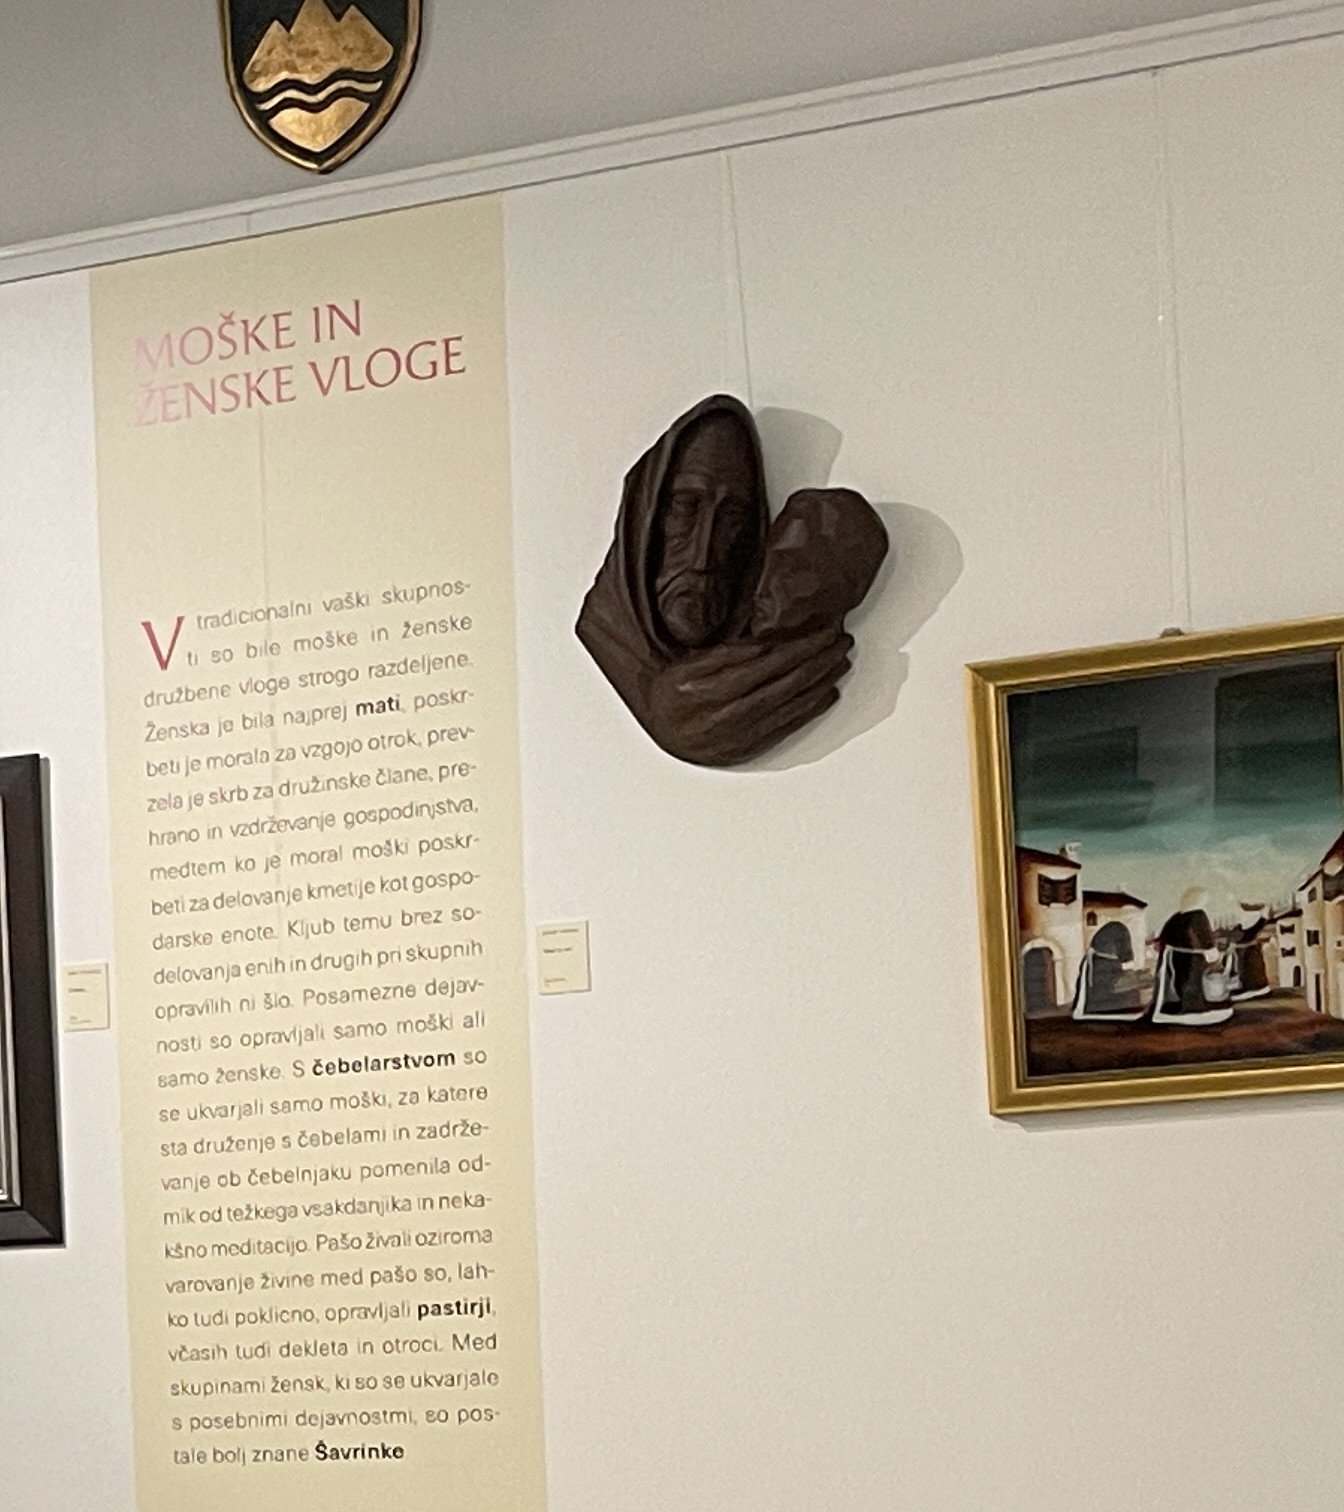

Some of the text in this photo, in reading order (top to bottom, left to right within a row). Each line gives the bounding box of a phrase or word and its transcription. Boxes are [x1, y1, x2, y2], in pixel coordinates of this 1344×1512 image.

[135, 299, 361, 371] MOŠKE IN
[135, 335, 467, 428] ŽENSKE VLOGE
[140, 615, 186, 671] V
[196, 600, 312, 630] tradicionalni
[322, 591, 370, 613] vaški
[187, 615, 472, 667] ti so bile moške in ženske
[143, 683, 231, 709] družbene
[238, 676, 290, 697] vloge
[298, 667, 360, 688] strogo
[144, 720, 210, 743] Ženska
[217, 719, 234, 738] je
[241, 711, 275, 731] bila
[282, 704, 348, 727] najprej
[146, 759, 181, 778] beti
[184, 756, 202, 778] je
[206, 747, 270, 770] morala
[274, 746, 297, 763] za
[301, 738, 364, 761] vzgojo
[147, 792, 184, 813] zela
[188, 792, 204, 812] je
[208, 784, 249, 806] skrb
[252, 785, 274, 801] za
[278, 771, 371, 797] družinske
[148, 827, 200, 847] hrano
[206, 825, 223, 840] in
[229, 812, 336, 838] vzdrževanje
[149, 860, 226, 882] medtem
[234, 855, 256, 872] ko
[263, 854, 282, 874] je
[290, 844, 343, 867] moral
[352, 838, 409, 861] moški
[151, 898, 185, 916] beti
[189, 897, 210, 913] za
[212, 887, 303, 910] delovanje
[306, 879, 376, 900] kmetije
[379, 875, 409, 893] kot
[152, 930, 213, 951] darske
[287, 917, 336, 940] Kljub
[343, 914, 393, 933] temu
[400, 909, 443, 927] brez
[153, 939, 483, 985] delovanja enih in drugih pri skupnih
[154, 997, 232, 1022] opravilih
[239, 998, 256, 1012] ni
[302, 983, 417, 1006] Posamezne
[156, 1010, 486, 1054] nosti so opravljali samo moški ali
[157, 1071, 210, 1089] samo
[292, 1059, 306, 1079] S
[311, 1052, 456, 1077] čebelarstvom
[463, 1049, 488, 1066] so
[158, 1085, 488, 1123] se ukvarjali samo moški, za katere
[160, 1141, 188, 1158] sta
[193, 1135, 276, 1155] druženje
[281, 1135, 292, 1149] s
[297, 1127, 387, 1149] čebelami
[392, 1126, 411, 1141] in
[161, 1174, 211, 1193] vanje
[217, 1169, 242, 1188] ob
[247, 1165, 352, 1187] čebelnjaku
[359, 1156, 451, 1183] pomenila
[163, 1207, 196, 1226] mik
[199, 1205, 223, 1224] od
[226, 1203, 299, 1223] težkega
[417, 1196, 435, 1211] in
[164, 1242, 208, 1260] kšno
[315, 1232, 363, 1252] Pašo
[365, 1230, 412, 1250] živali
[414, 1228, 493, 1247] oziroma
[165, 1275, 255, 1295] varovanje
[260, 1271, 315, 1290] živine
[320, 1267, 364, 1286] med
[370, 1265, 418, 1288] pašo
[423, 1267, 452, 1283] so,
[167, 1311, 189, 1328] ko
[193, 1309, 229, 1328] tudi
[324, 1300, 411, 1325] opravljali
[167, 1343, 228, 1362] včasih
[235, 1341, 271, 1361] tudi
[278, 1339, 349, 1359] dekleta
[357, 1340, 375, 1355] in
[451, 1332, 497, 1352] Med
[170, 1379, 266, 1398] skupinami
[335, 1373, 351, 1391] ki
[354, 1375, 378, 1391] so
[382, 1374, 406, 1390] se
[172, 1416, 183, 1431] s
[189, 1411, 288, 1433] posebnimi
[425, 1408, 449, 1424] so
[173, 1439, 405, 1467] tale bolj znane Šavrinke
